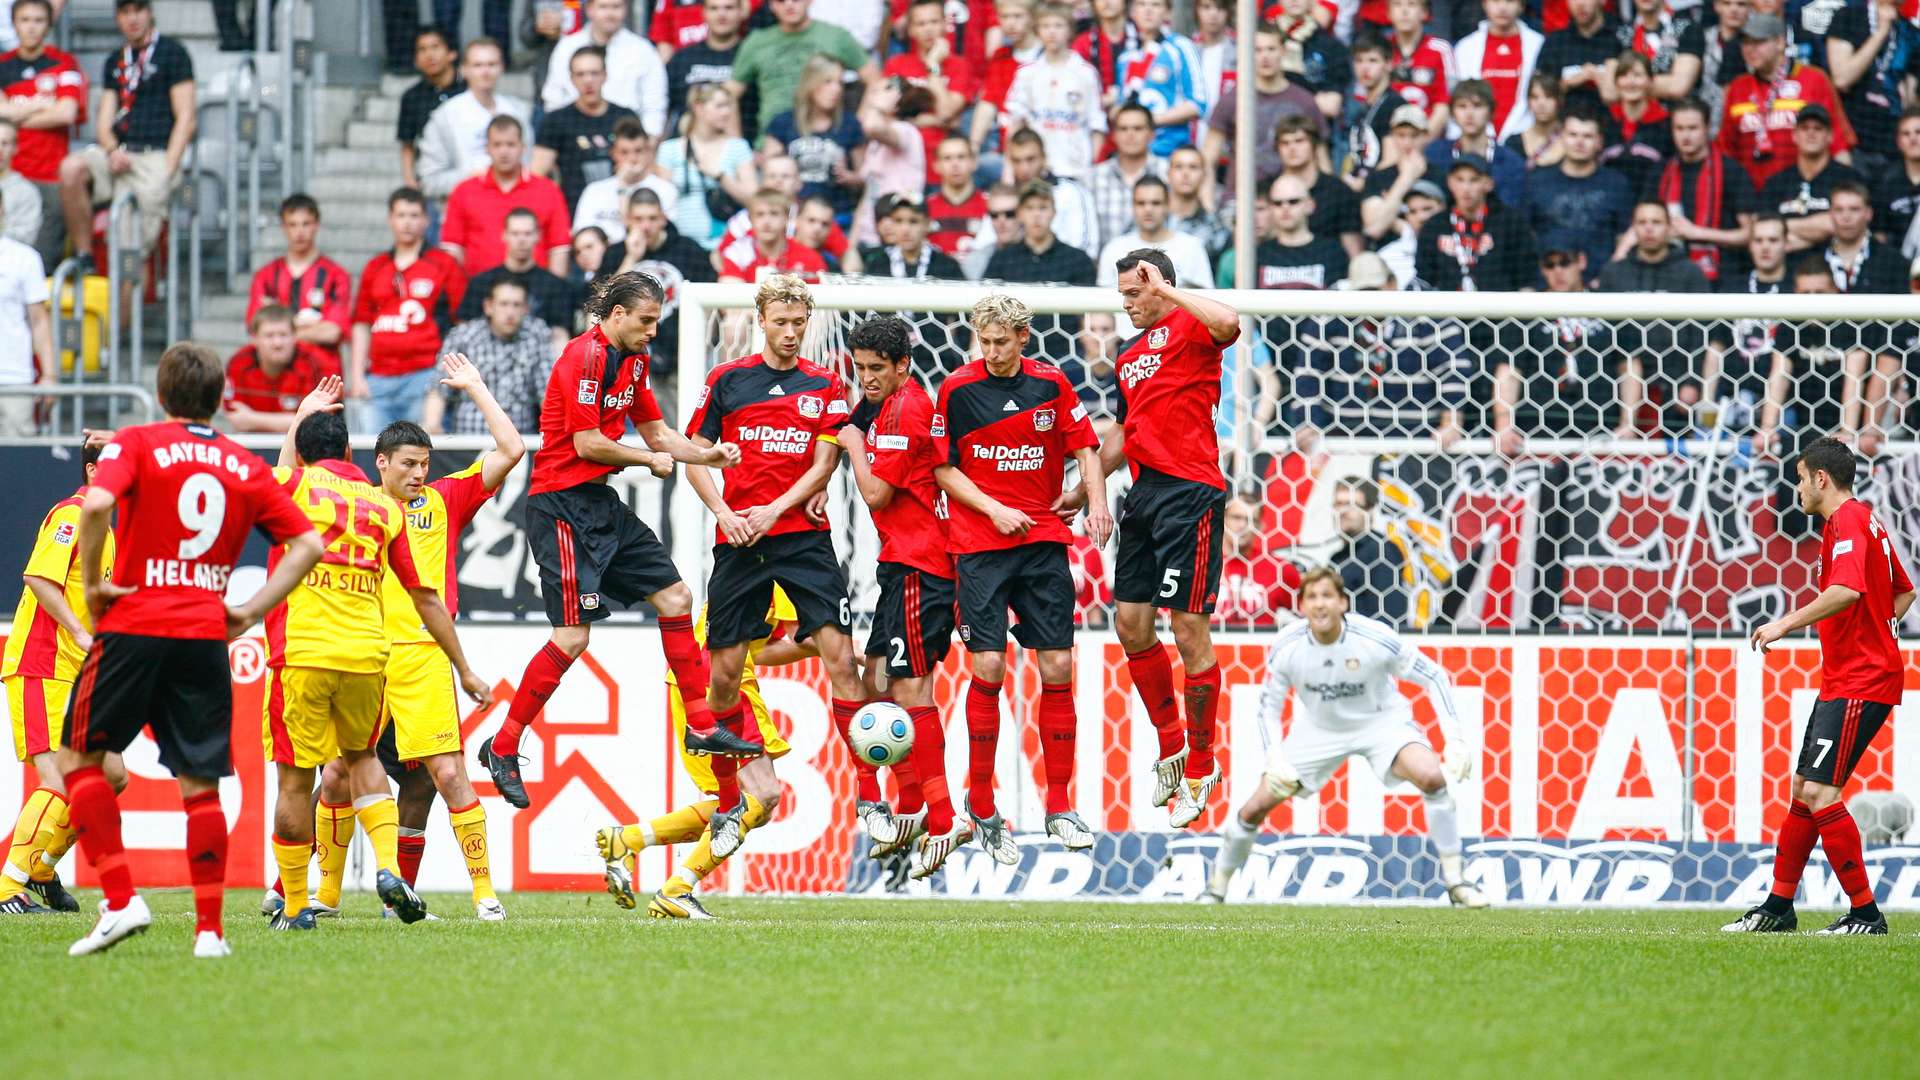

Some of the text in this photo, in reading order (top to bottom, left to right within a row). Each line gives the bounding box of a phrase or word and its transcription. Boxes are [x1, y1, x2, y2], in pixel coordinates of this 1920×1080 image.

[154, 442, 222, 469] BAYER
[762, 442, 808, 453] ENERG
[972, 445, 1044, 460] TelDaFax
[997, 459, 1044, 472] ENERGY
[178, 472, 226, 560] 9
[308, 487, 389, 572] 25
[145, 558, 230, 592] HELMES
[306, 571, 380, 595] DA SILV
[1160, 568, 1180, 598] 5
[839, 597, 851, 626] 6
[890, 637, 908, 667] 2
[1811, 737, 1834, 769] 7
[465, 838, 483, 855] KSC
